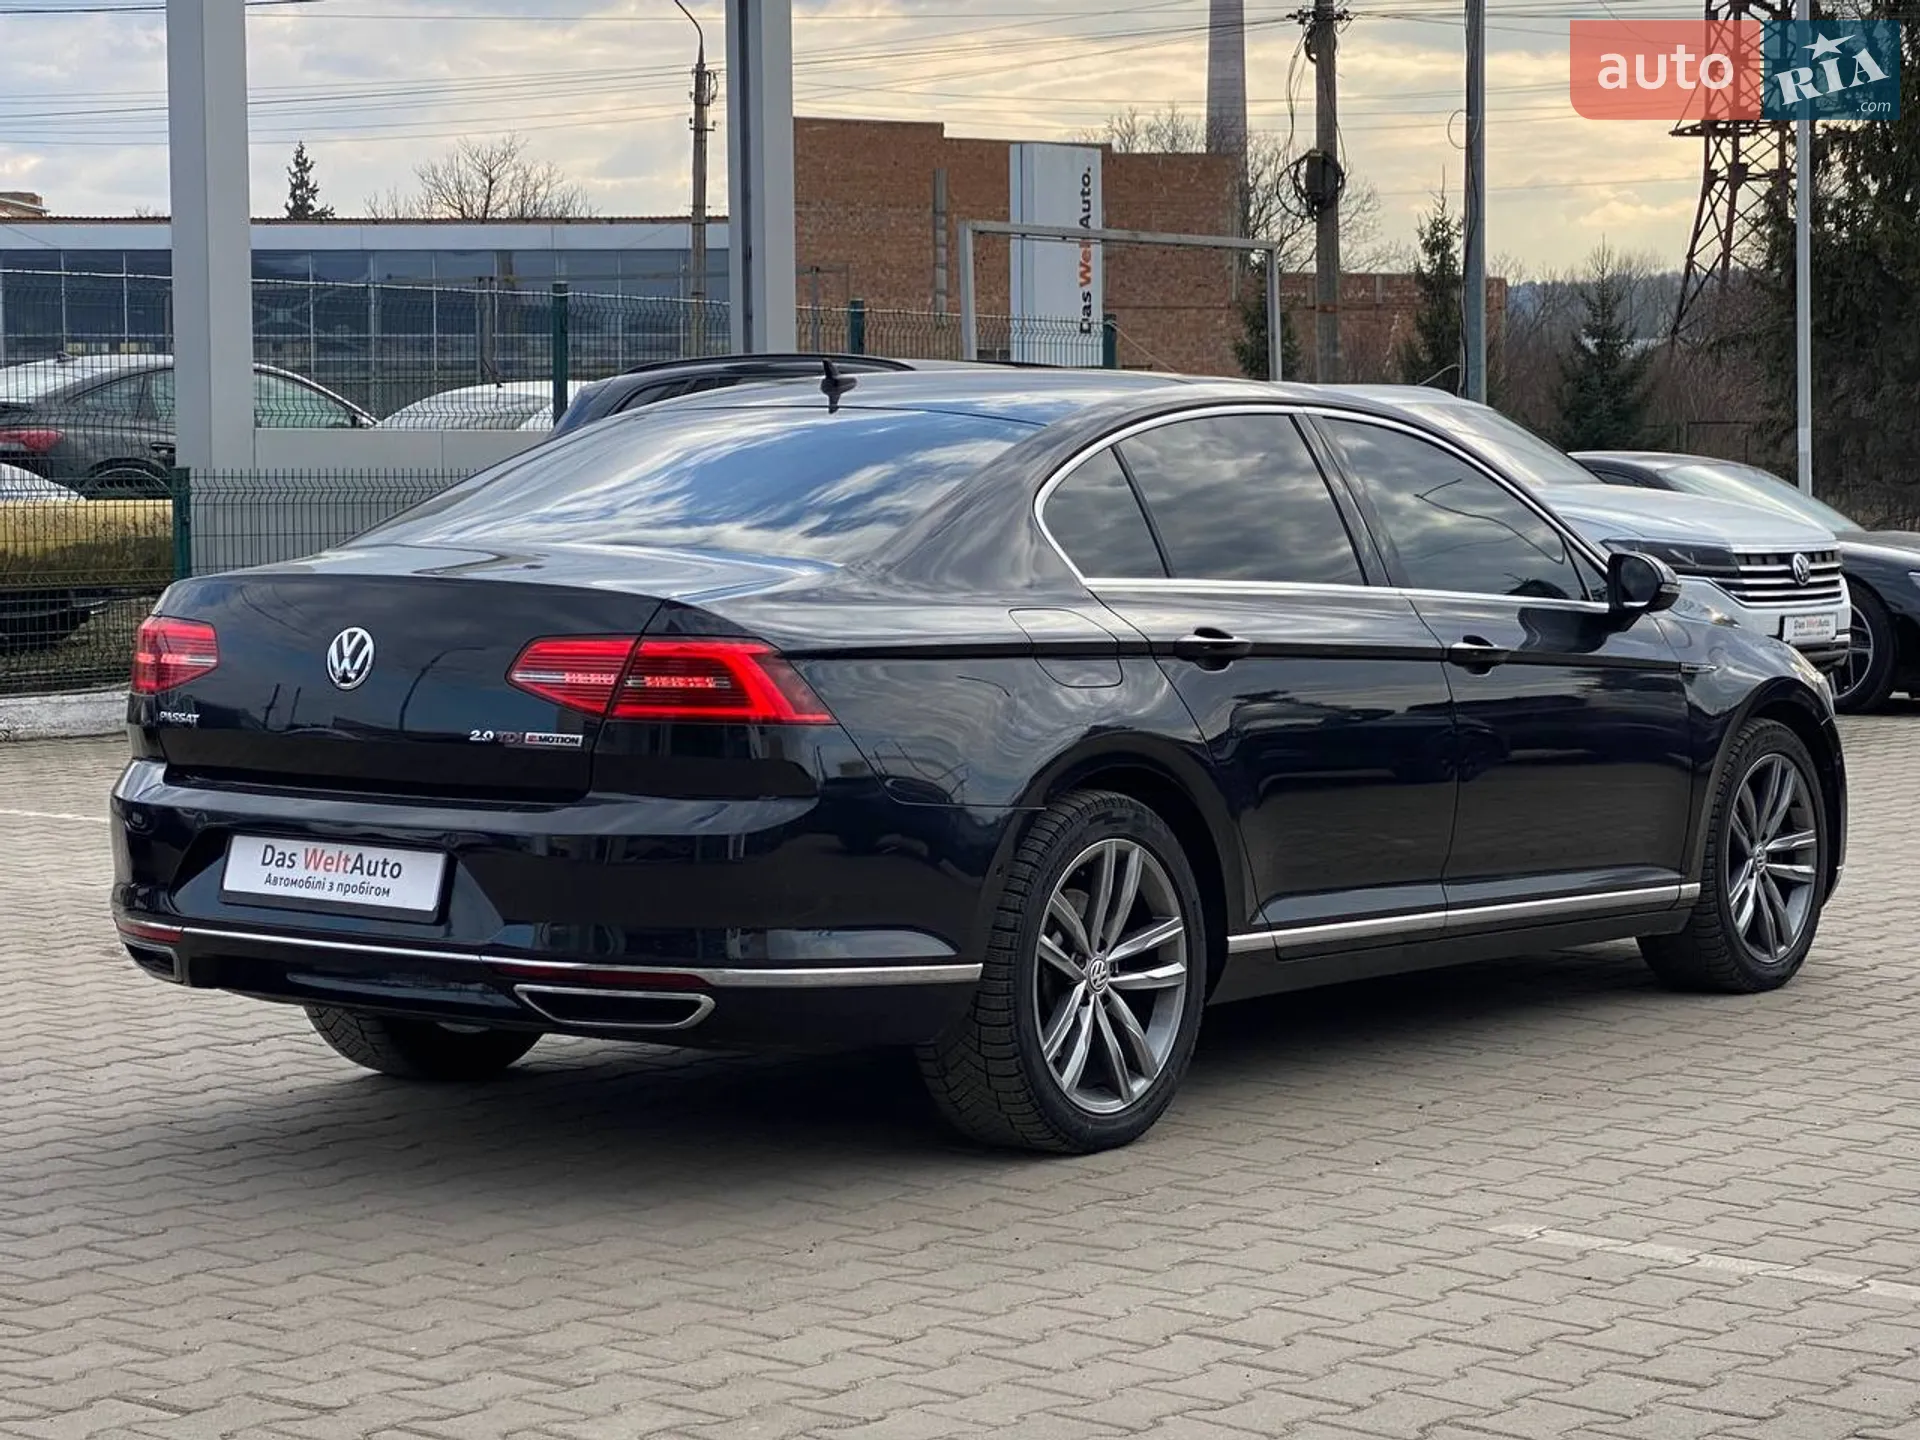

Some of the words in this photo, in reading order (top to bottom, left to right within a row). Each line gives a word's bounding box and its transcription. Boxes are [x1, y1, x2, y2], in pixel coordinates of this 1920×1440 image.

[1079, 166, 1092, 288] WelAuto.
[1079, 291, 1092, 334] Das
[159, 710, 200, 727] PASSAT
[469, 729, 495, 742] 2.0
[261, 844, 297, 869] Das
[304, 847, 403, 879] WeltAuto
[264, 872, 326, 891] Автомобілі
[328, 881, 334, 892] з
[336, 880, 391, 898] пробігом
